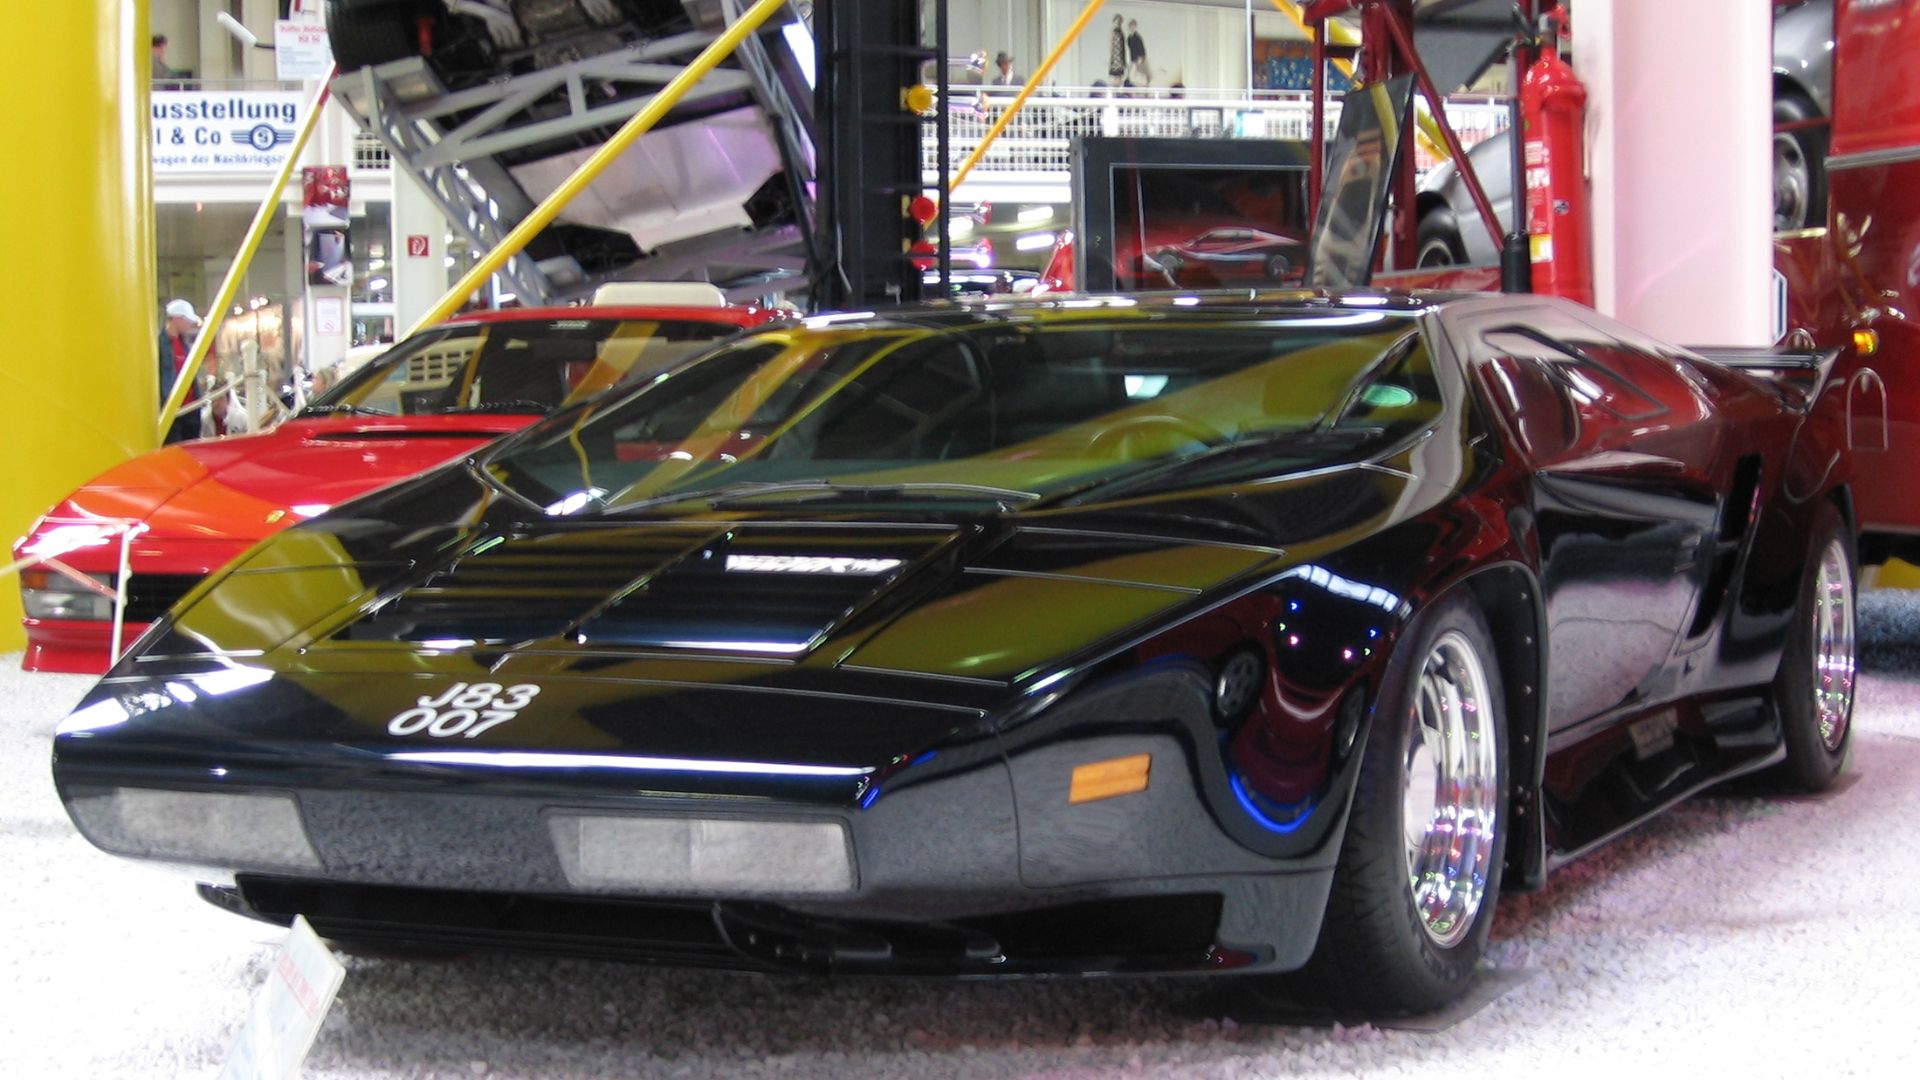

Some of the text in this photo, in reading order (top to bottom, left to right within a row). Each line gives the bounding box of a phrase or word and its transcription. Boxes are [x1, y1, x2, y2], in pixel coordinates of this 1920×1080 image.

[170, 127, 186, 145] &
[195, 126, 222, 145] Co
[417, 682, 541, 710] J83
[387, 706, 518, 738] 007
